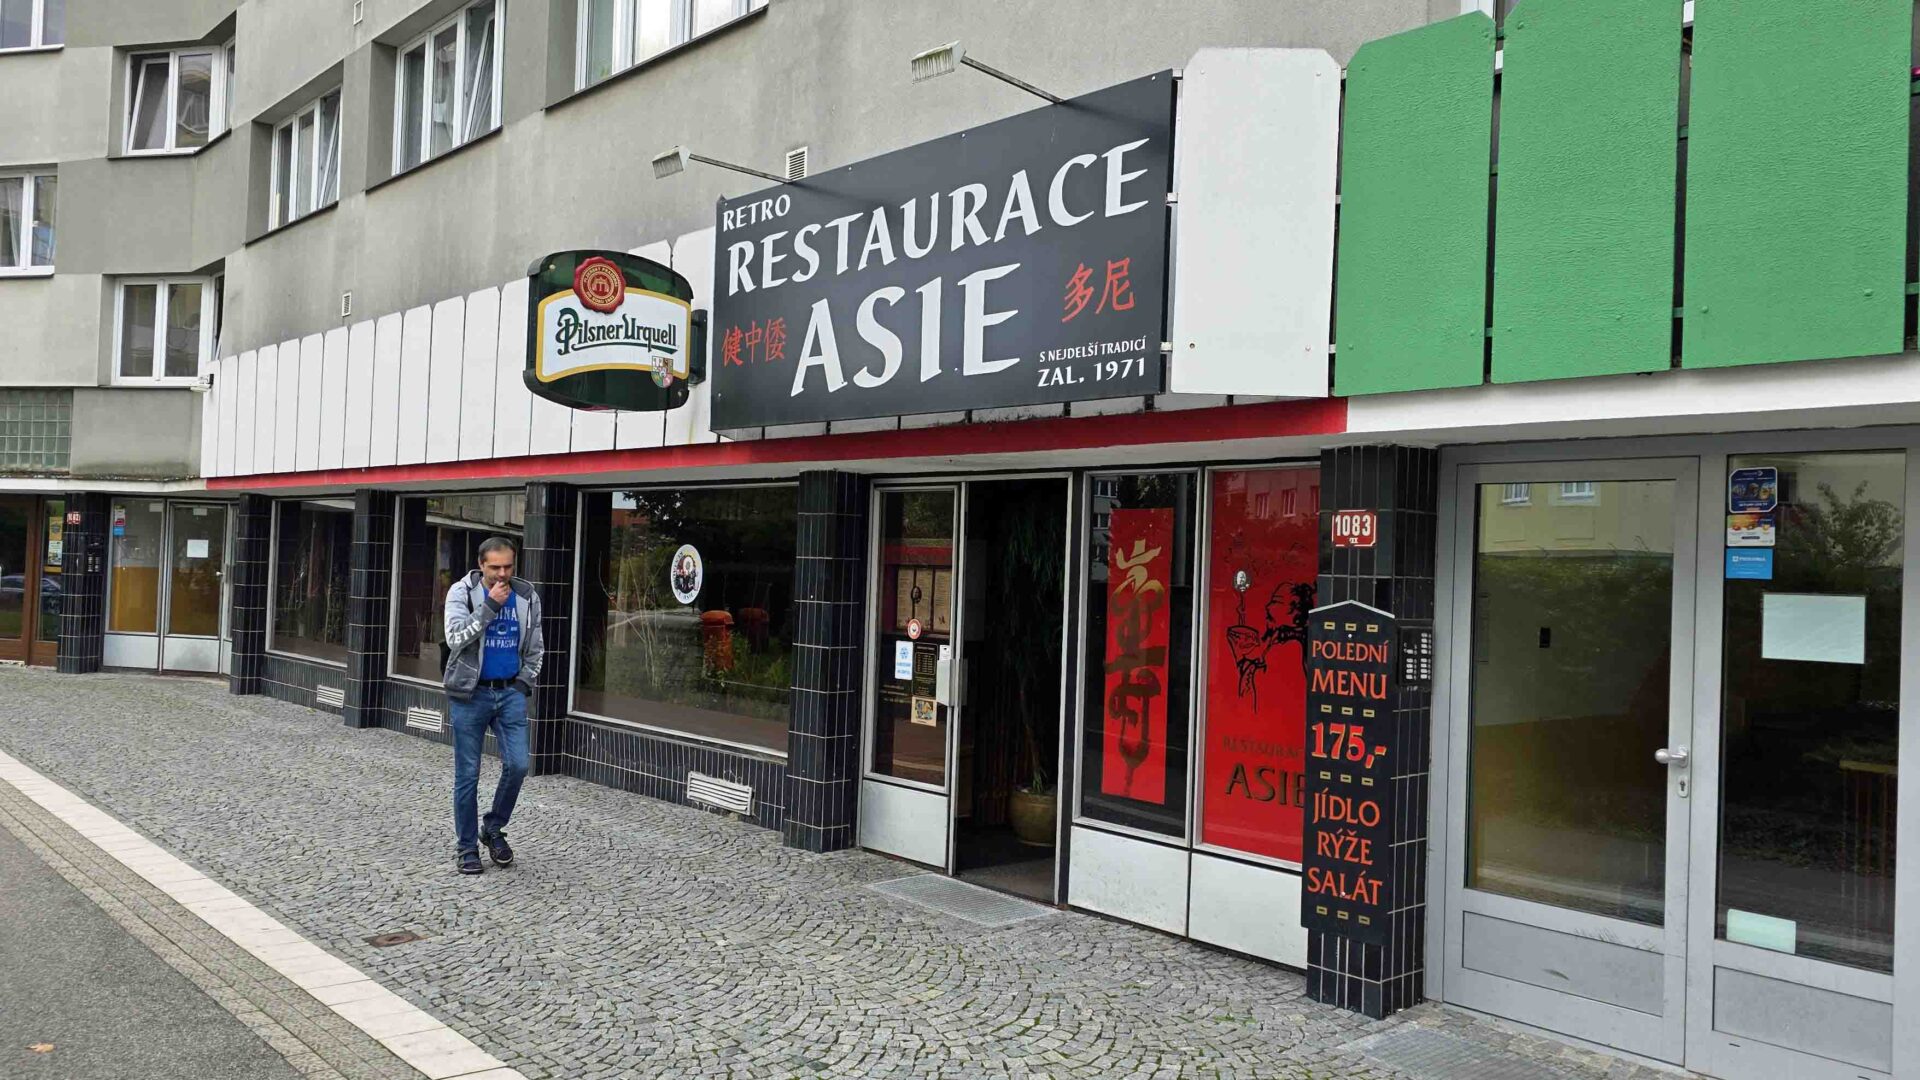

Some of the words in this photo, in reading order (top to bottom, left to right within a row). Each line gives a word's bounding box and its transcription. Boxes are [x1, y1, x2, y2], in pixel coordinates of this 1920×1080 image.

[723, 194, 791, 232] RETRO
[727, 138, 1150, 297] RESTAURACE
[1062, 257, 1135, 323] 多尼
[555, 307, 623, 355] Pilsner
[621, 313, 677, 353] Urquell
[790, 263, 1021, 397] ASIE
[1039, 351, 1046, 363] S
[1048, 341, 1099, 361] NEJDELŠÍ
[1100, 335, 1146, 355] TRADICÍ
[1037, 365, 1085, 387] ZAL.
[1093, 357, 1145, 382] 1971
[1335, 514, 1371, 537] 1083
[1312, 640, 1389, 663] POLEDNÍ
[1311, 668, 1388, 700] MENU
[1223, 735, 1305, 758] RESTAURAC
[1311, 722, 1387, 769] 175,-
[1225, 762, 1305, 809] ASIE
[1312, 787, 1381, 827] JÍDLO
[1317, 828, 1374, 866] RÝŽE
[1307, 867, 1383, 906] SALÁT
